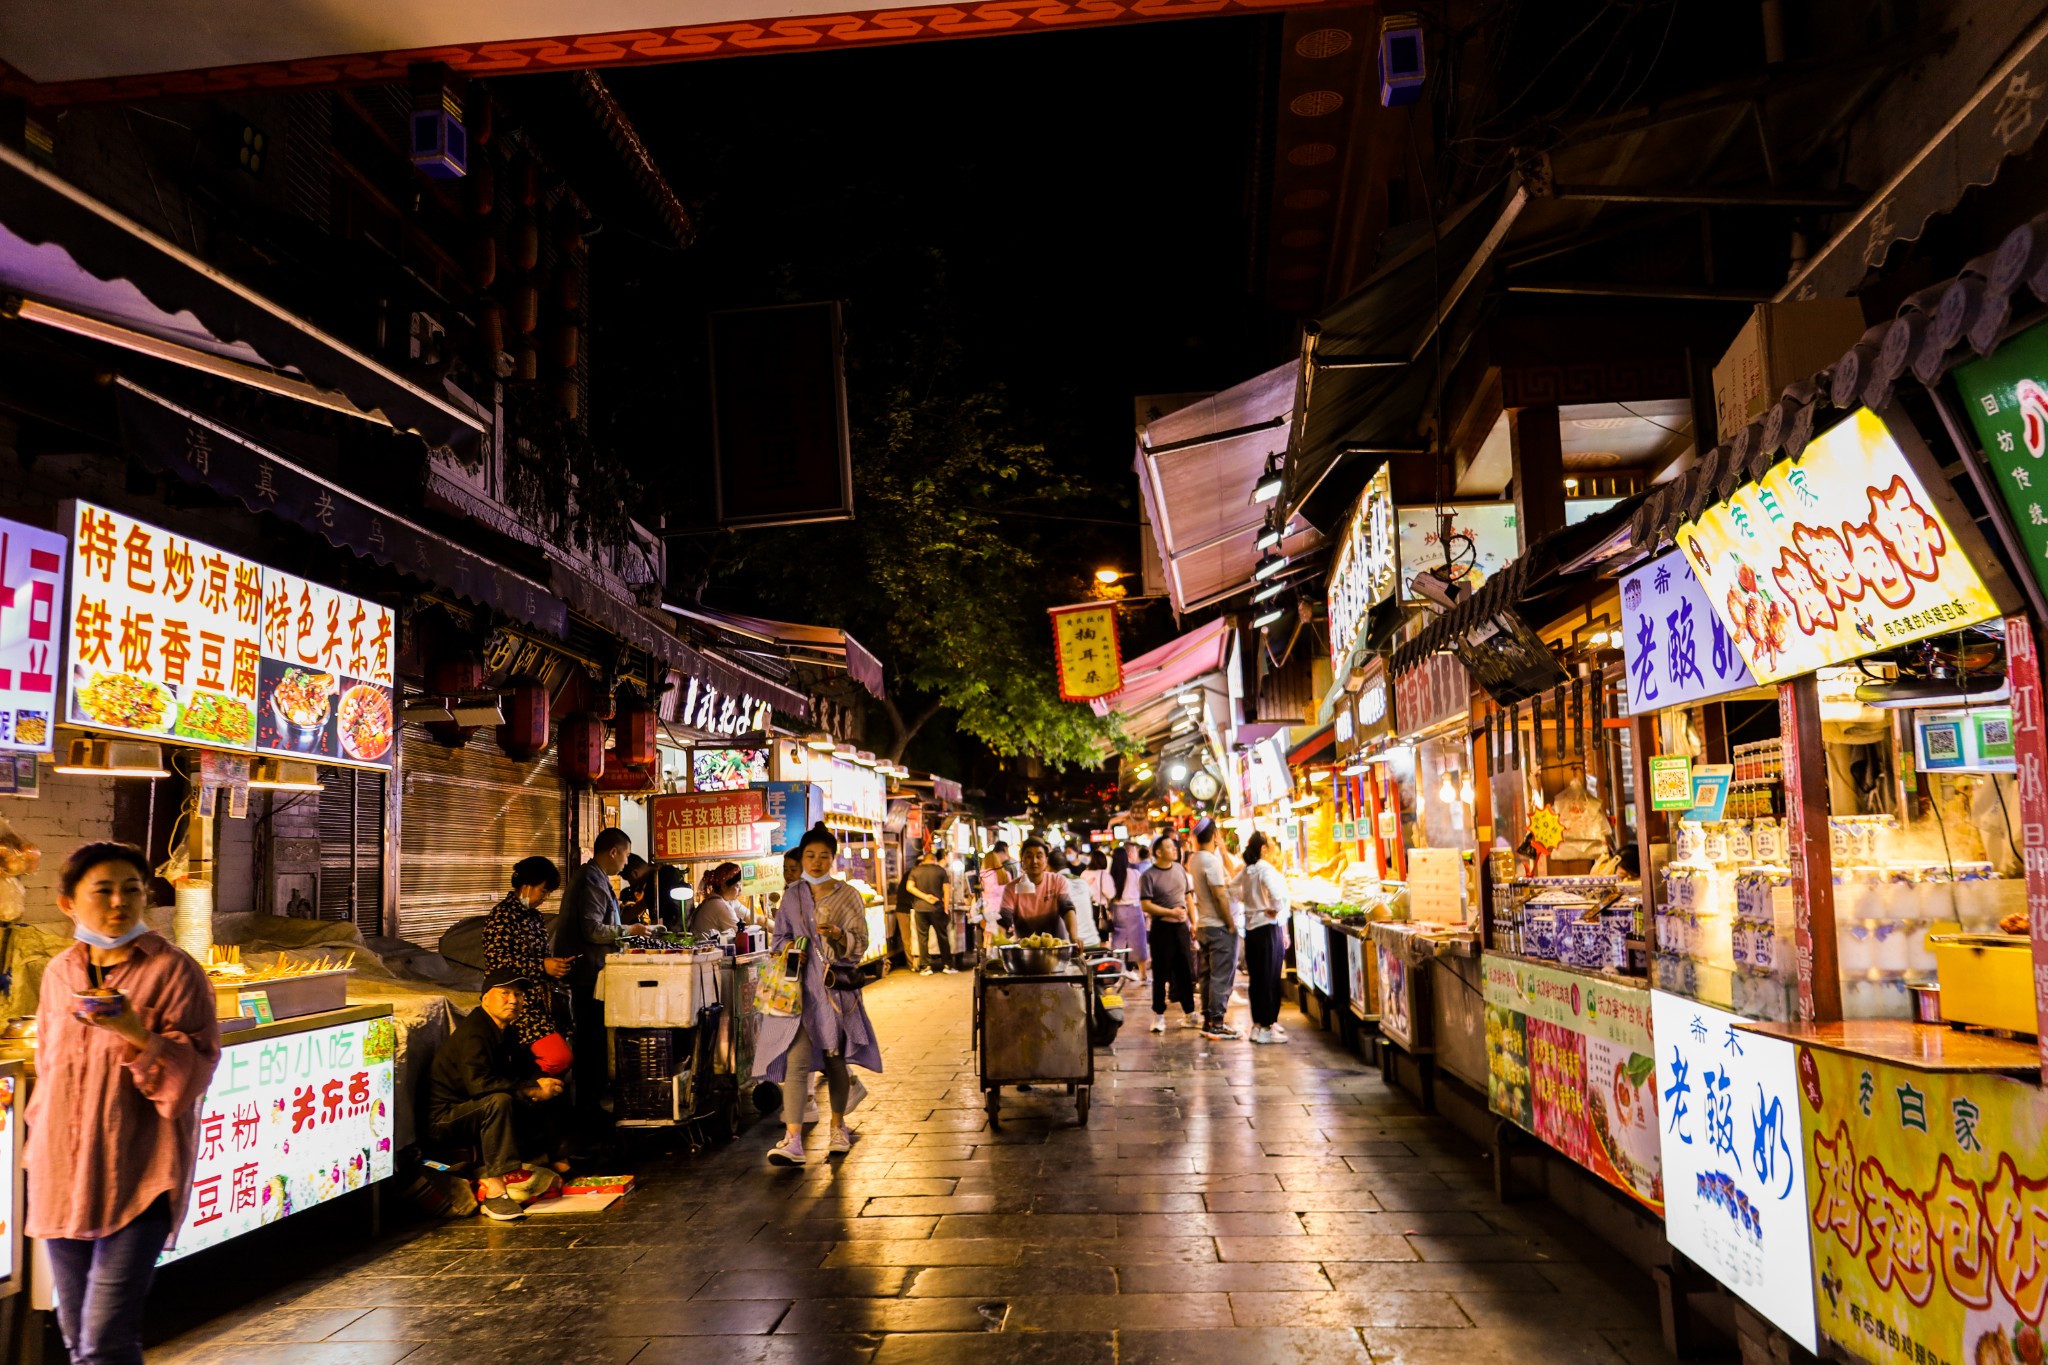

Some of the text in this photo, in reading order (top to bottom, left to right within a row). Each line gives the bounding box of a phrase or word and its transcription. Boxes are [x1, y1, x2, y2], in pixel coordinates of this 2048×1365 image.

[79, 507, 262, 626] 特色炒凉粉
[75, 594, 261, 700] 铁板香豆腐
[265, 577, 393, 683] 特色关东煮
[666, 804, 752, 828] 八宝玫瑰镜糕
[292, 1071, 370, 1134] 关东煮
[1801, 1053, 1819, 1102] 清真
[1858, 1068, 1983, 1153] 老白家
[1665, 1045, 1794, 1200] 老酸奶
[193, 1161, 259, 1228] 豆腐
[1850, 1302, 1952, 1365] 有态度的鸡翅包
